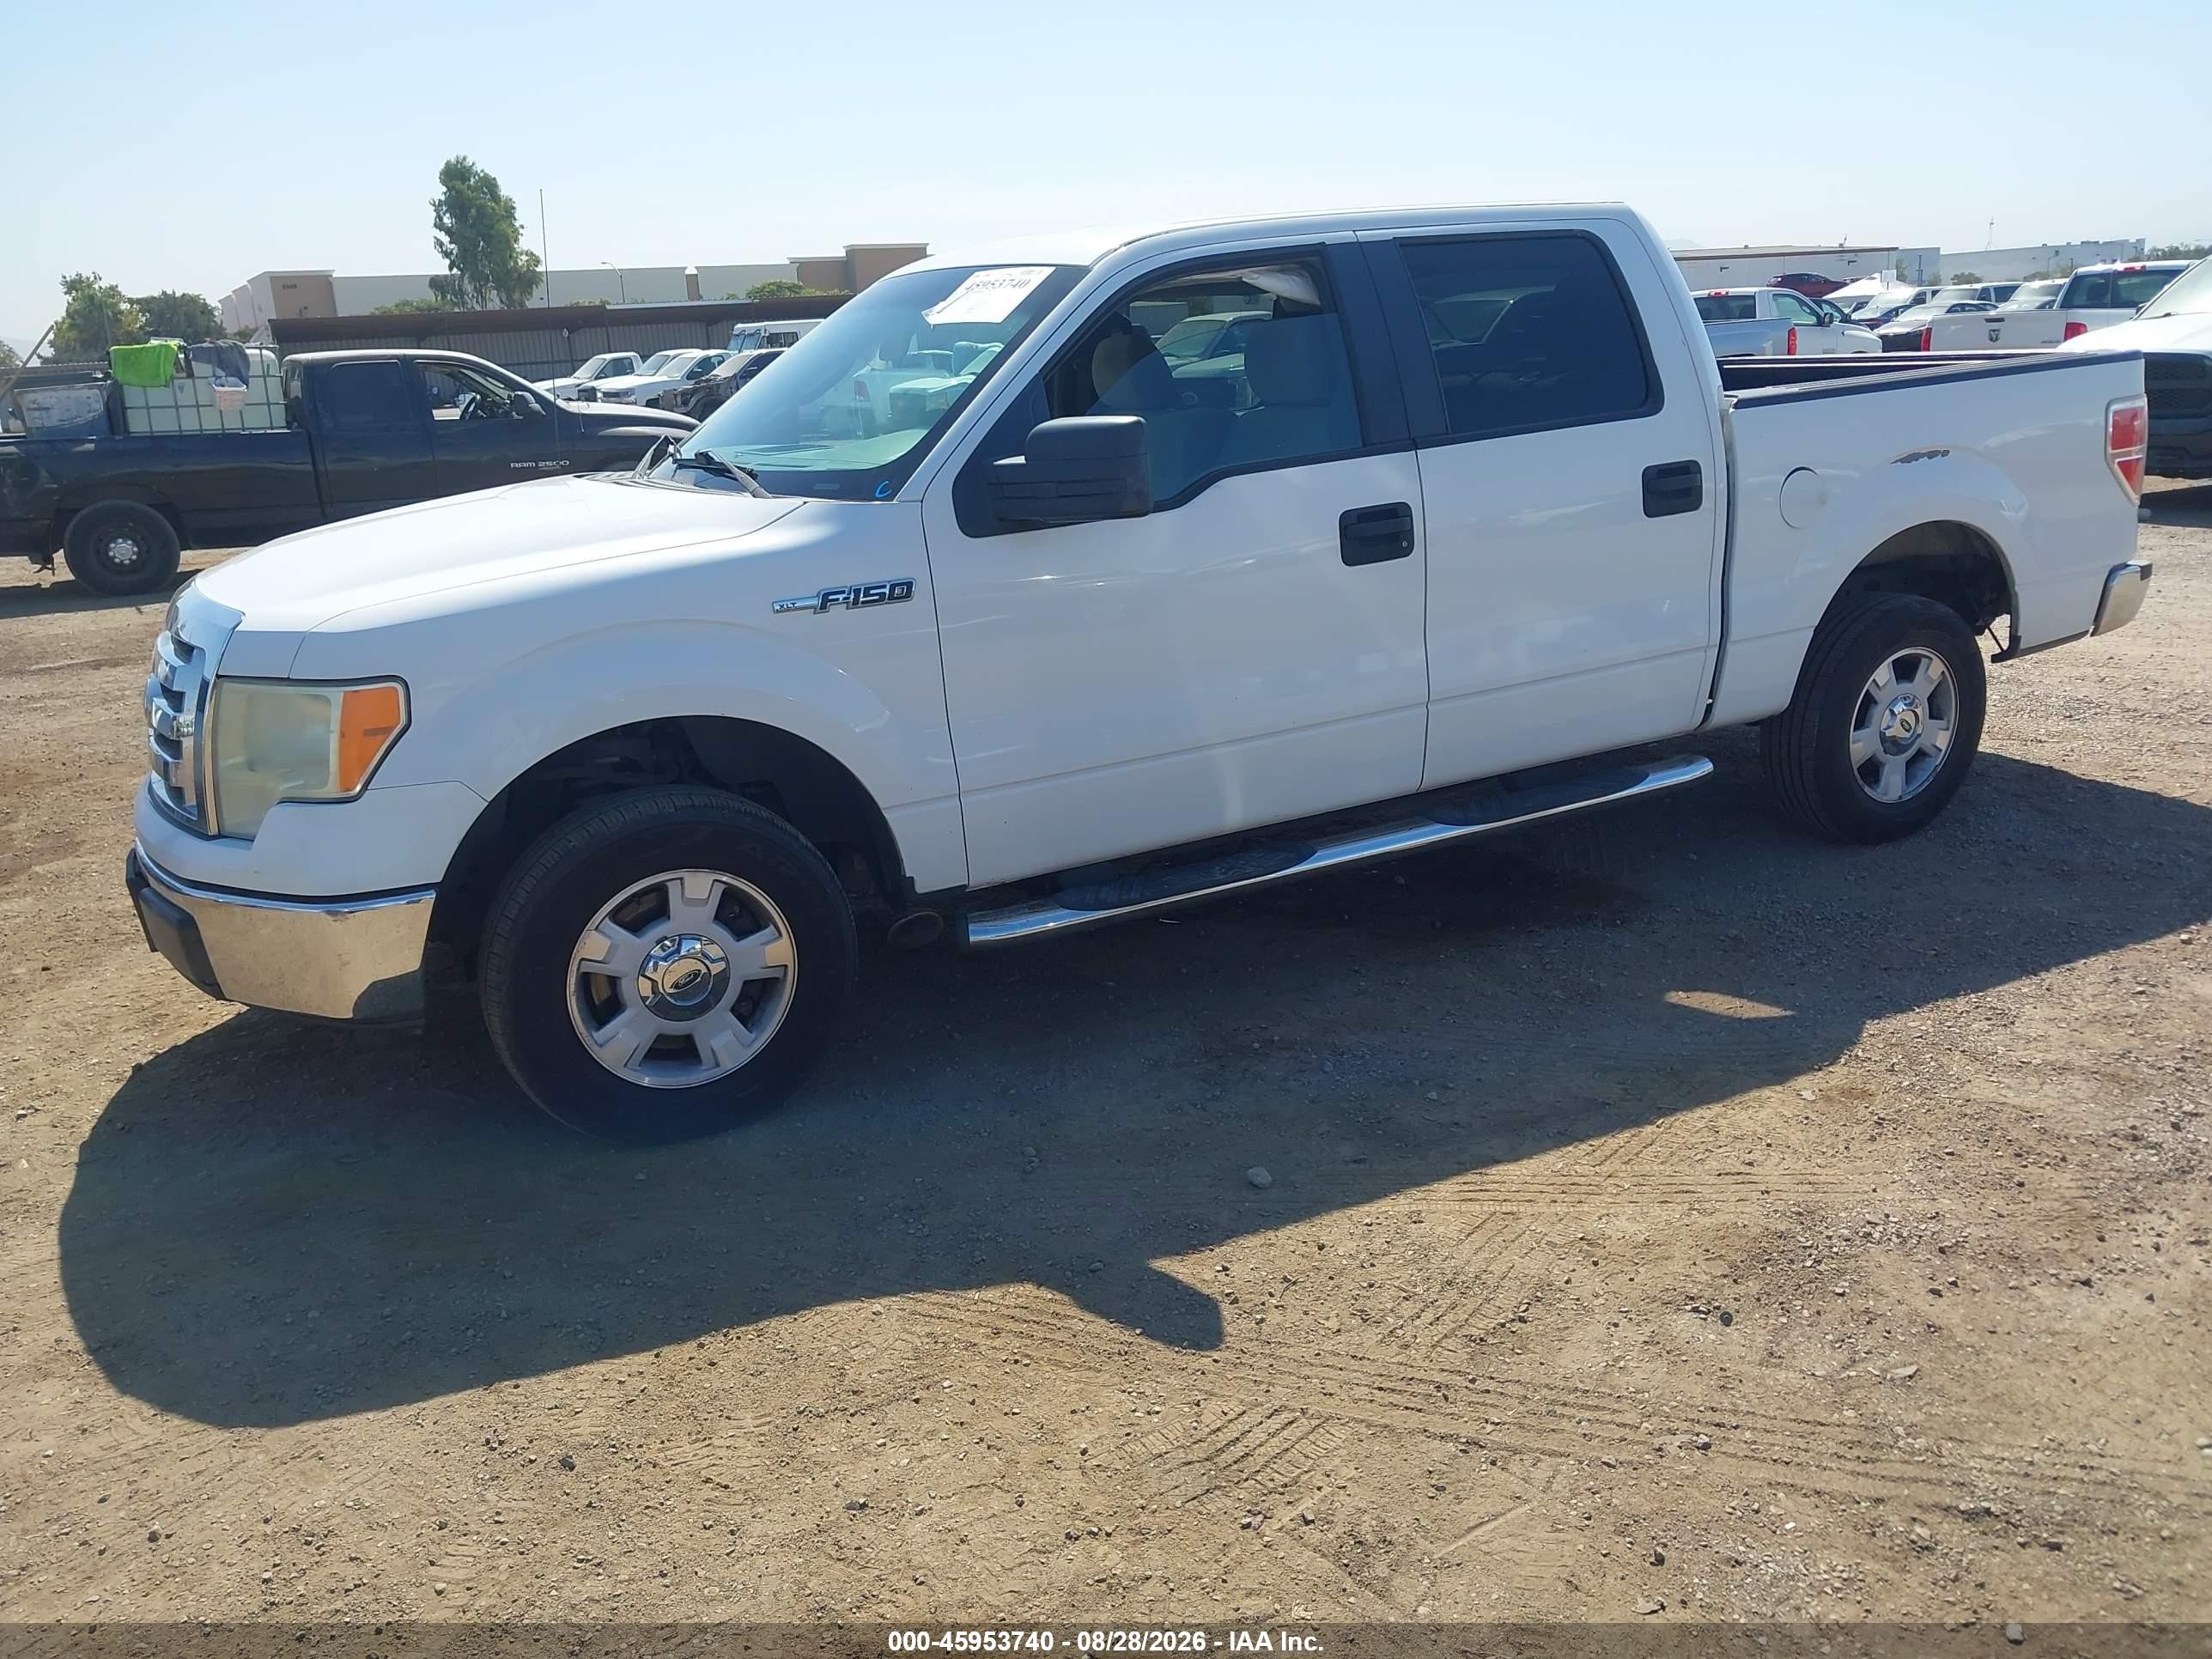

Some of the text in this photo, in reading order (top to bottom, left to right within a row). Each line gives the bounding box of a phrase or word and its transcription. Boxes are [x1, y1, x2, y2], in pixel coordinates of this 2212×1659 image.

[964, 278, 1031, 291] 45953740
[778, 580, 915, 612] XLT F-150
